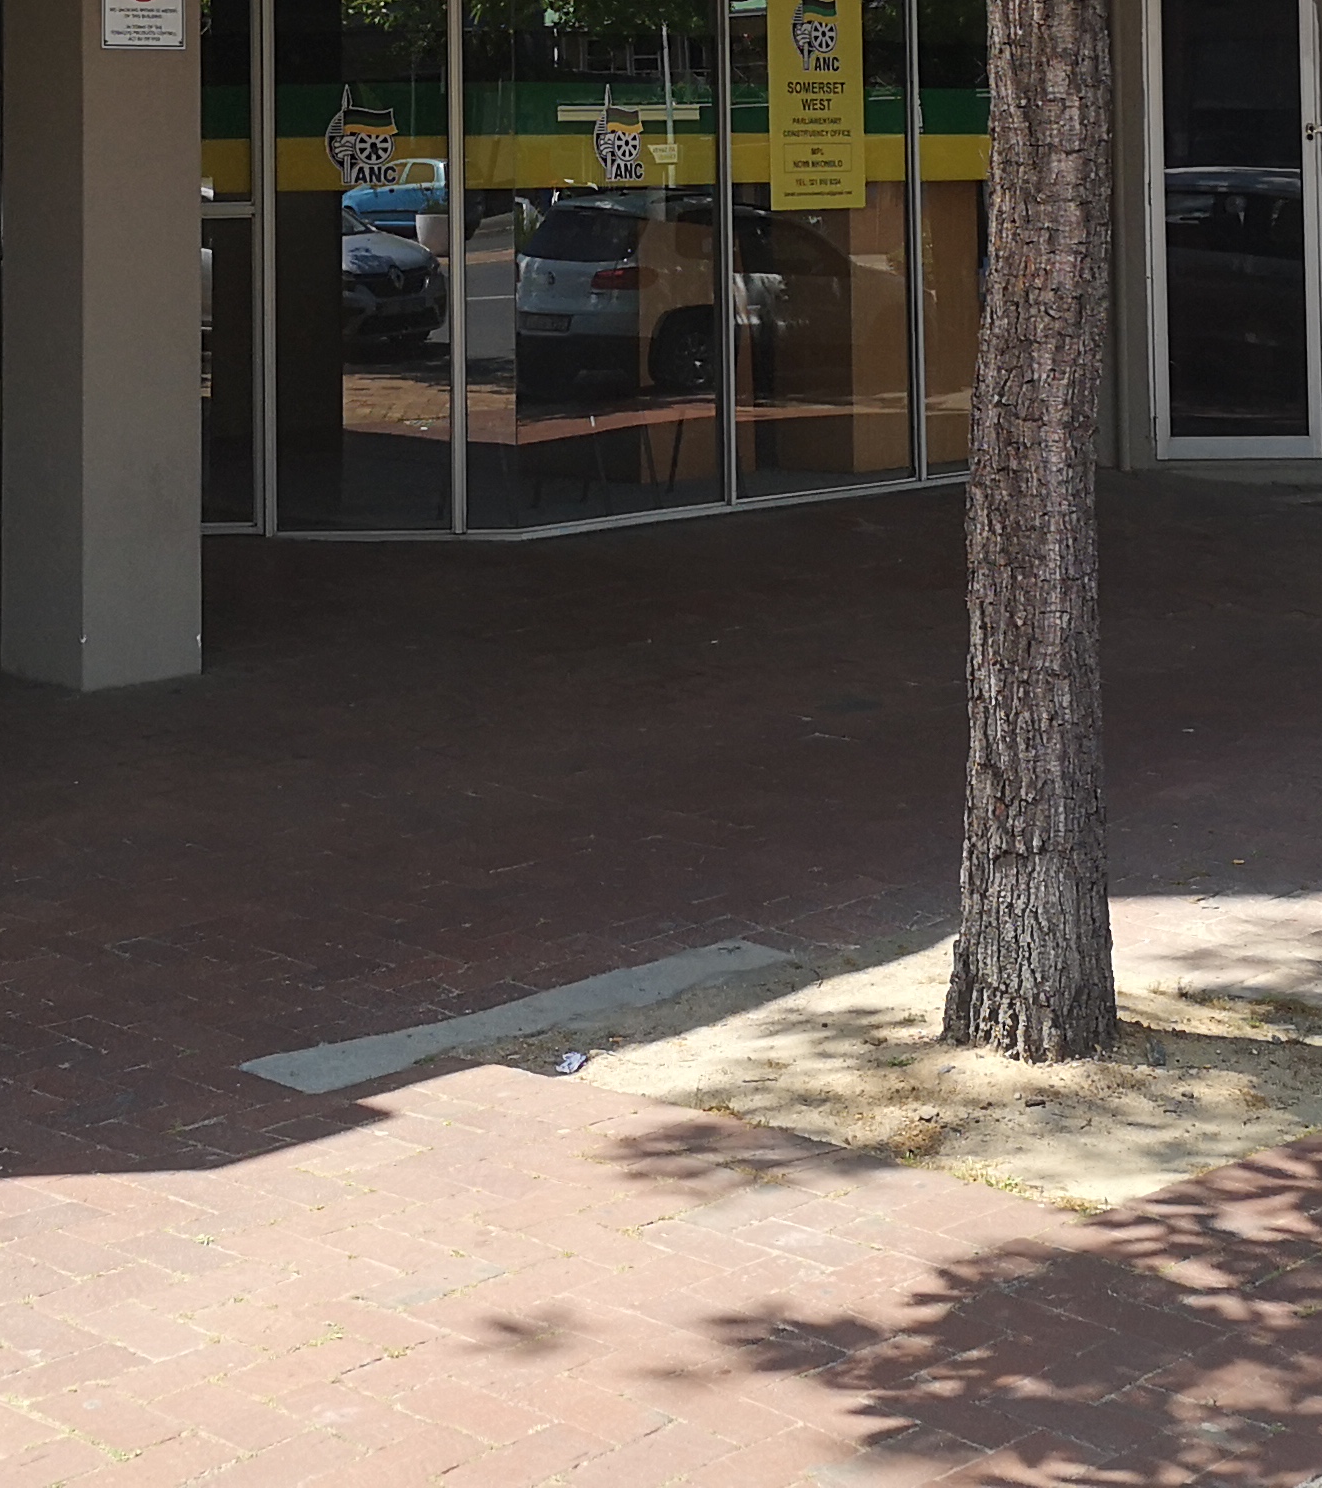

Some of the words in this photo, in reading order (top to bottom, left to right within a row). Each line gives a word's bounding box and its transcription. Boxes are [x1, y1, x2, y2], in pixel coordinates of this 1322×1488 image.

[814, 56, 840, 72] ANC
[787, 81, 846, 94] SOMERSET
[801, 98, 832, 111] WEST
[354, 166, 397, 184] ANC
[614, 162, 644, 179] ANC
